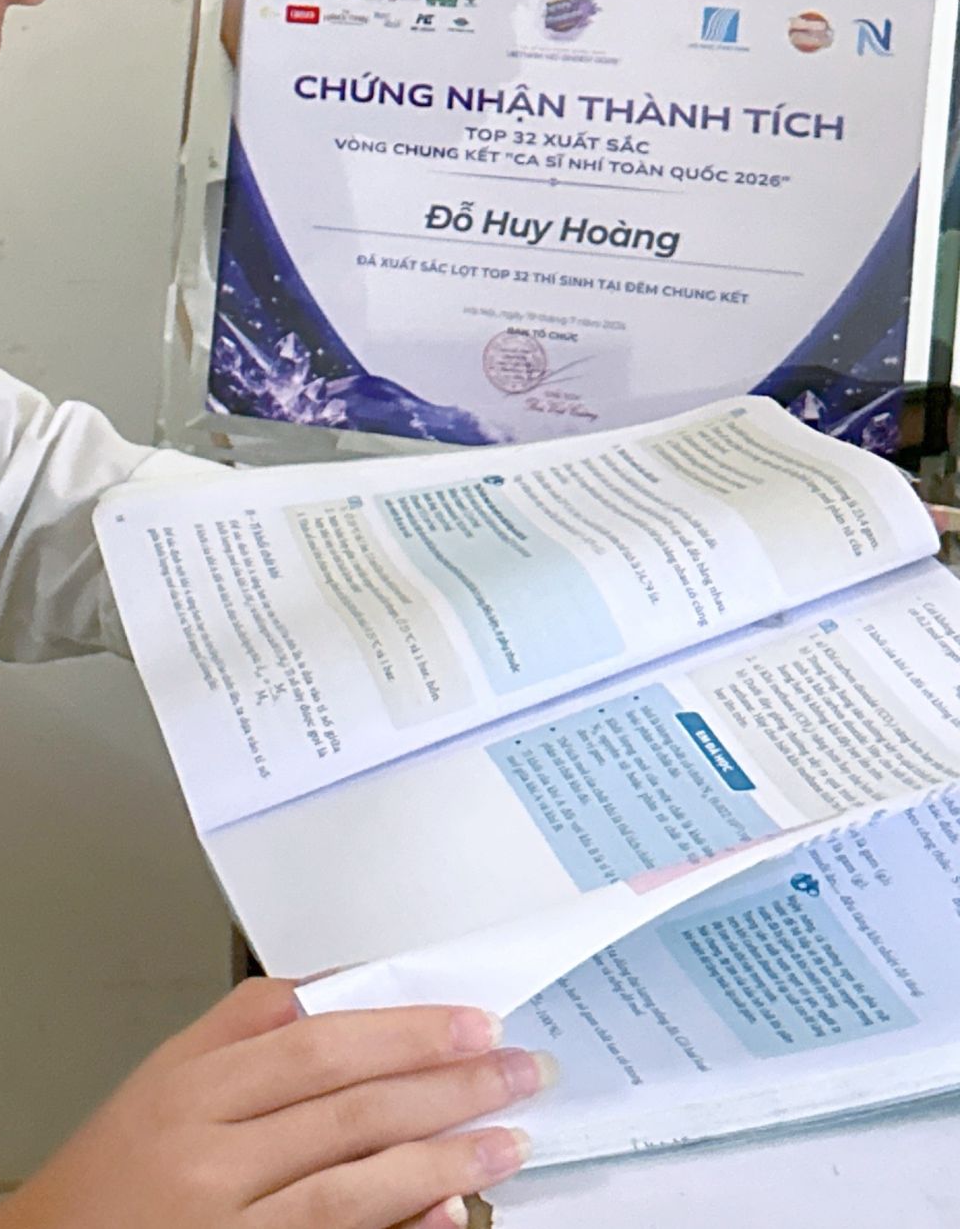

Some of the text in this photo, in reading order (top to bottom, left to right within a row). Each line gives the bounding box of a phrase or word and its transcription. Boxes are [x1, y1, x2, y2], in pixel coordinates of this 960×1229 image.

[294, 72, 844, 141] CHỨNG NHẬN THÀNH TÍCH
[334, 135, 388, 154] VÒNG
[393, 143, 460, 160] CHUNG
[465, 145, 500, 163] KẾT
[546, 150, 563, 168] SĨ
[568, 154, 605, 172] NHÍ
[609, 160, 664, 177] TOÀN
[669, 164, 730, 183] QUỐC
[465, 126, 651, 155] TOP 32 XUẤT SẮC
[425, 201, 680, 258] Đỗ Huy Hoàng
[482, 267, 510, 280] TOP
[513, 271, 529, 282] 32
[560, 275, 594, 289] SINH
[662, 285, 716, 302] CHUNG
